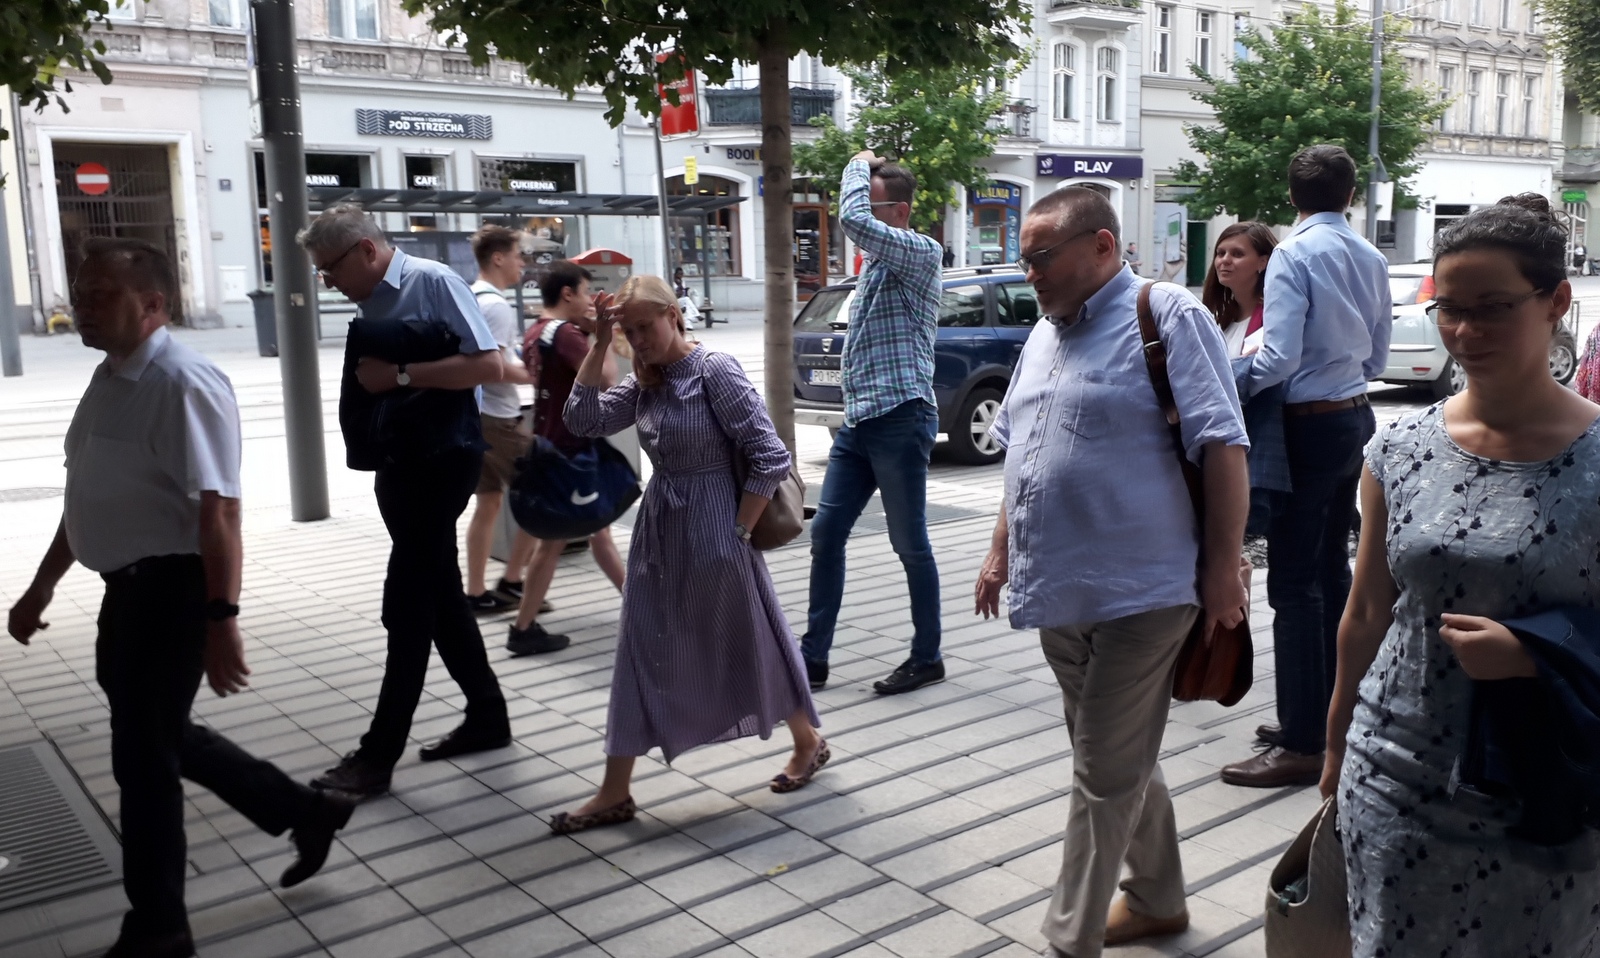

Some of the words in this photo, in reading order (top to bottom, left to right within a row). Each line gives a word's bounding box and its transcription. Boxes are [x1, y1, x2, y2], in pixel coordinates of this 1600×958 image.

[388, 120, 410, 130] POD
[1074, 160, 1113, 174] PLAY
[305, 175, 339, 186] ARNIA
[414, 176, 437, 186] CAFE
[510, 181, 554, 190] CUKIERNIA
